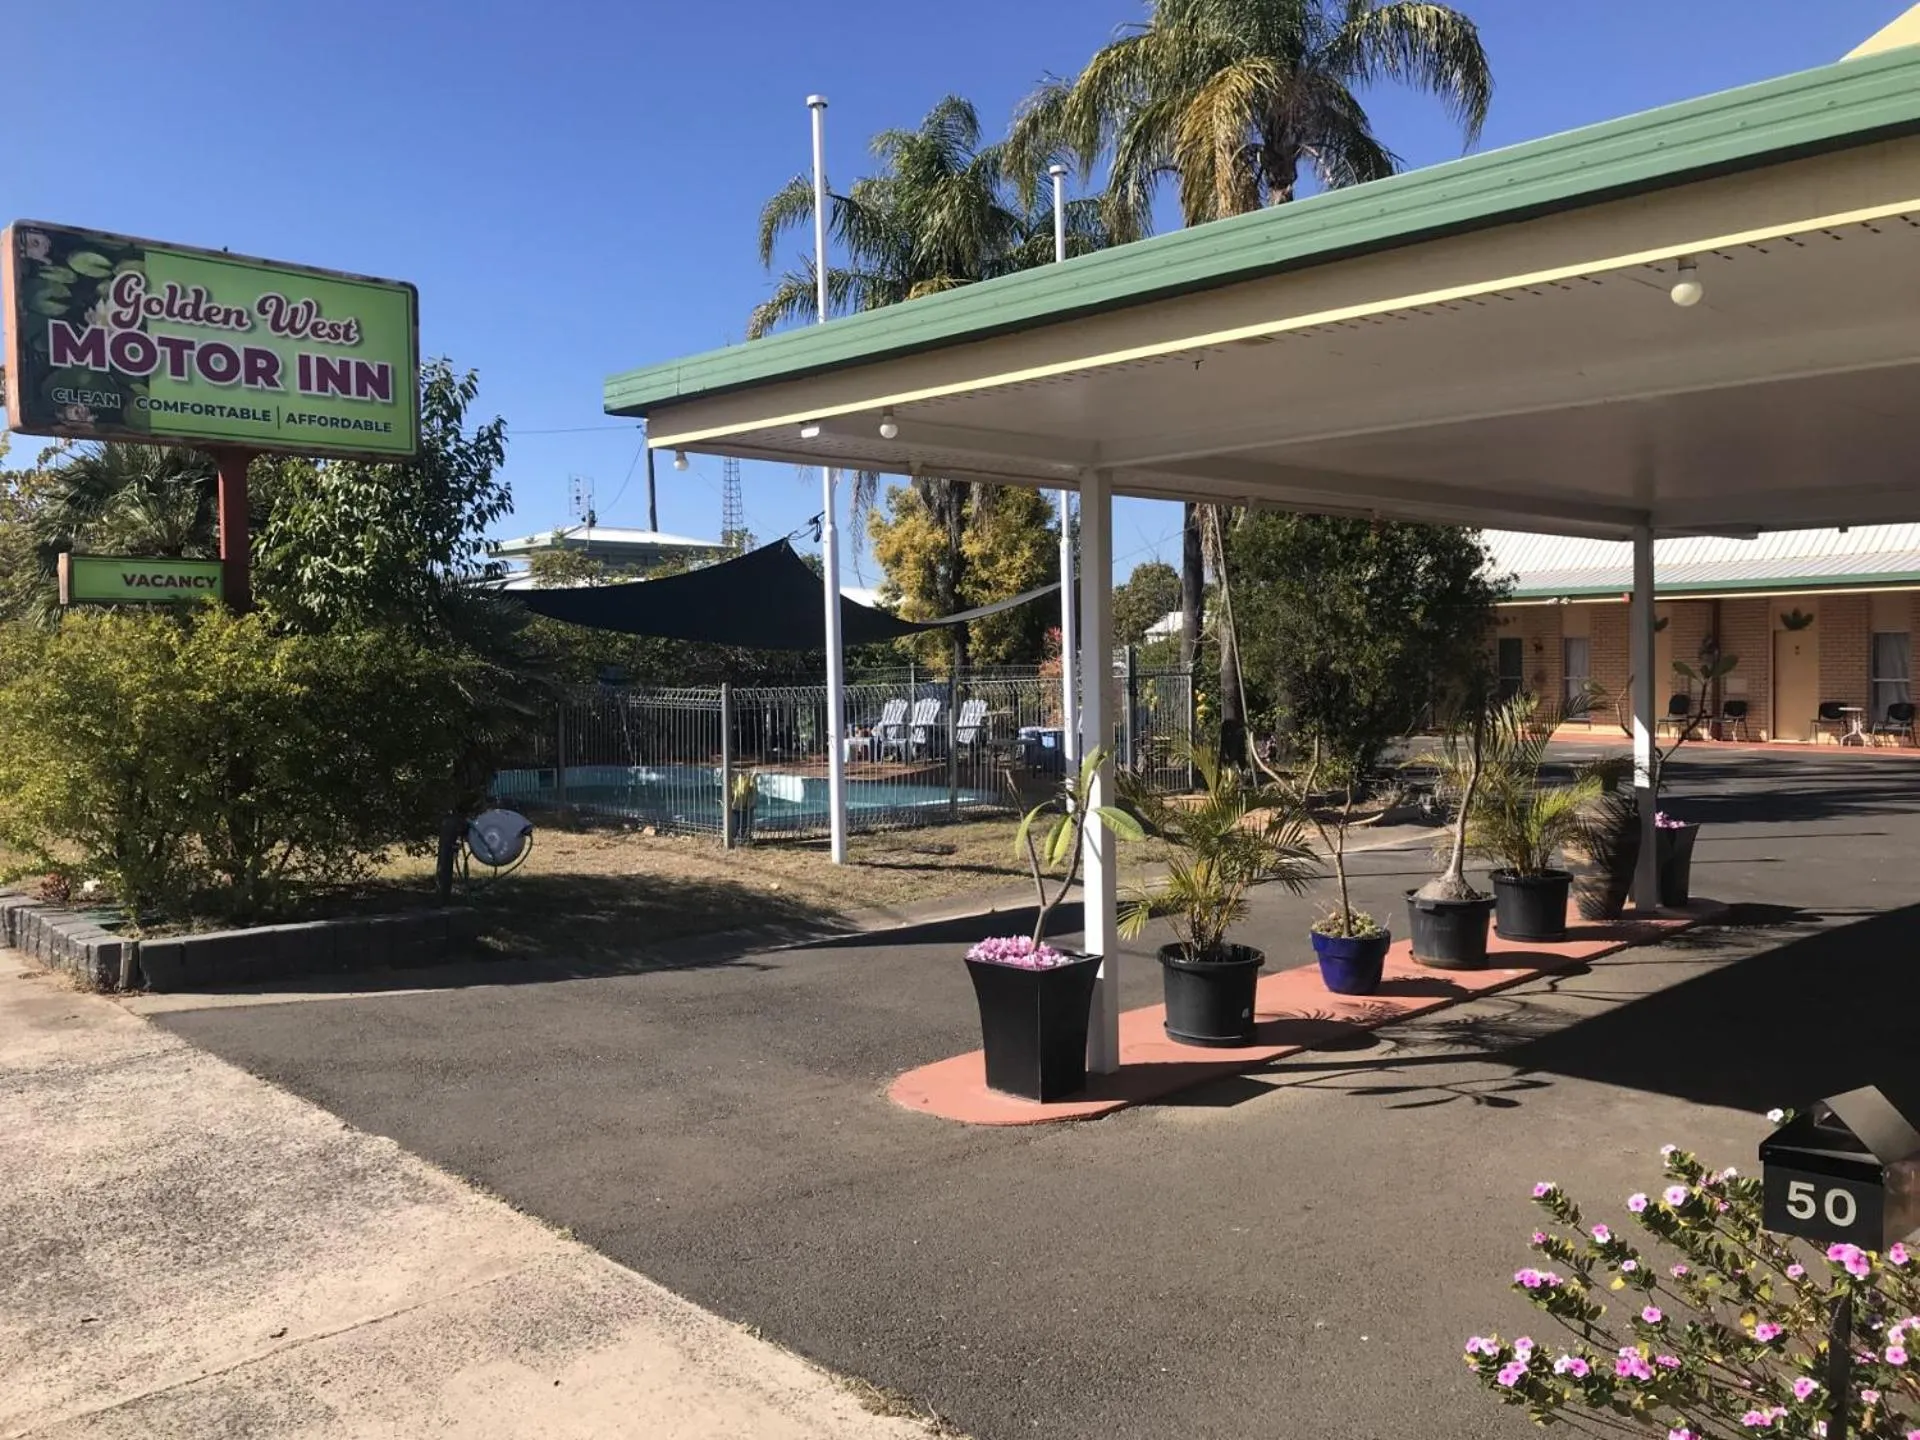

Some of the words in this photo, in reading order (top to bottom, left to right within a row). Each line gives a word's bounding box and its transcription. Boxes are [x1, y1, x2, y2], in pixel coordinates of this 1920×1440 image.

[110, 271, 250, 331] Golden
[256, 293, 363, 346] West
[48, 320, 285, 392] MOTOR
[298, 354, 393, 402] INN
[52, 387, 121, 409] CLEAN
[136, 397, 272, 423] COMFORTABLE
[286, 412, 392, 434] AFFORDABLE
[122, 573, 217, 589] VACANCY
[1786, 1180, 1857, 1227] 50
